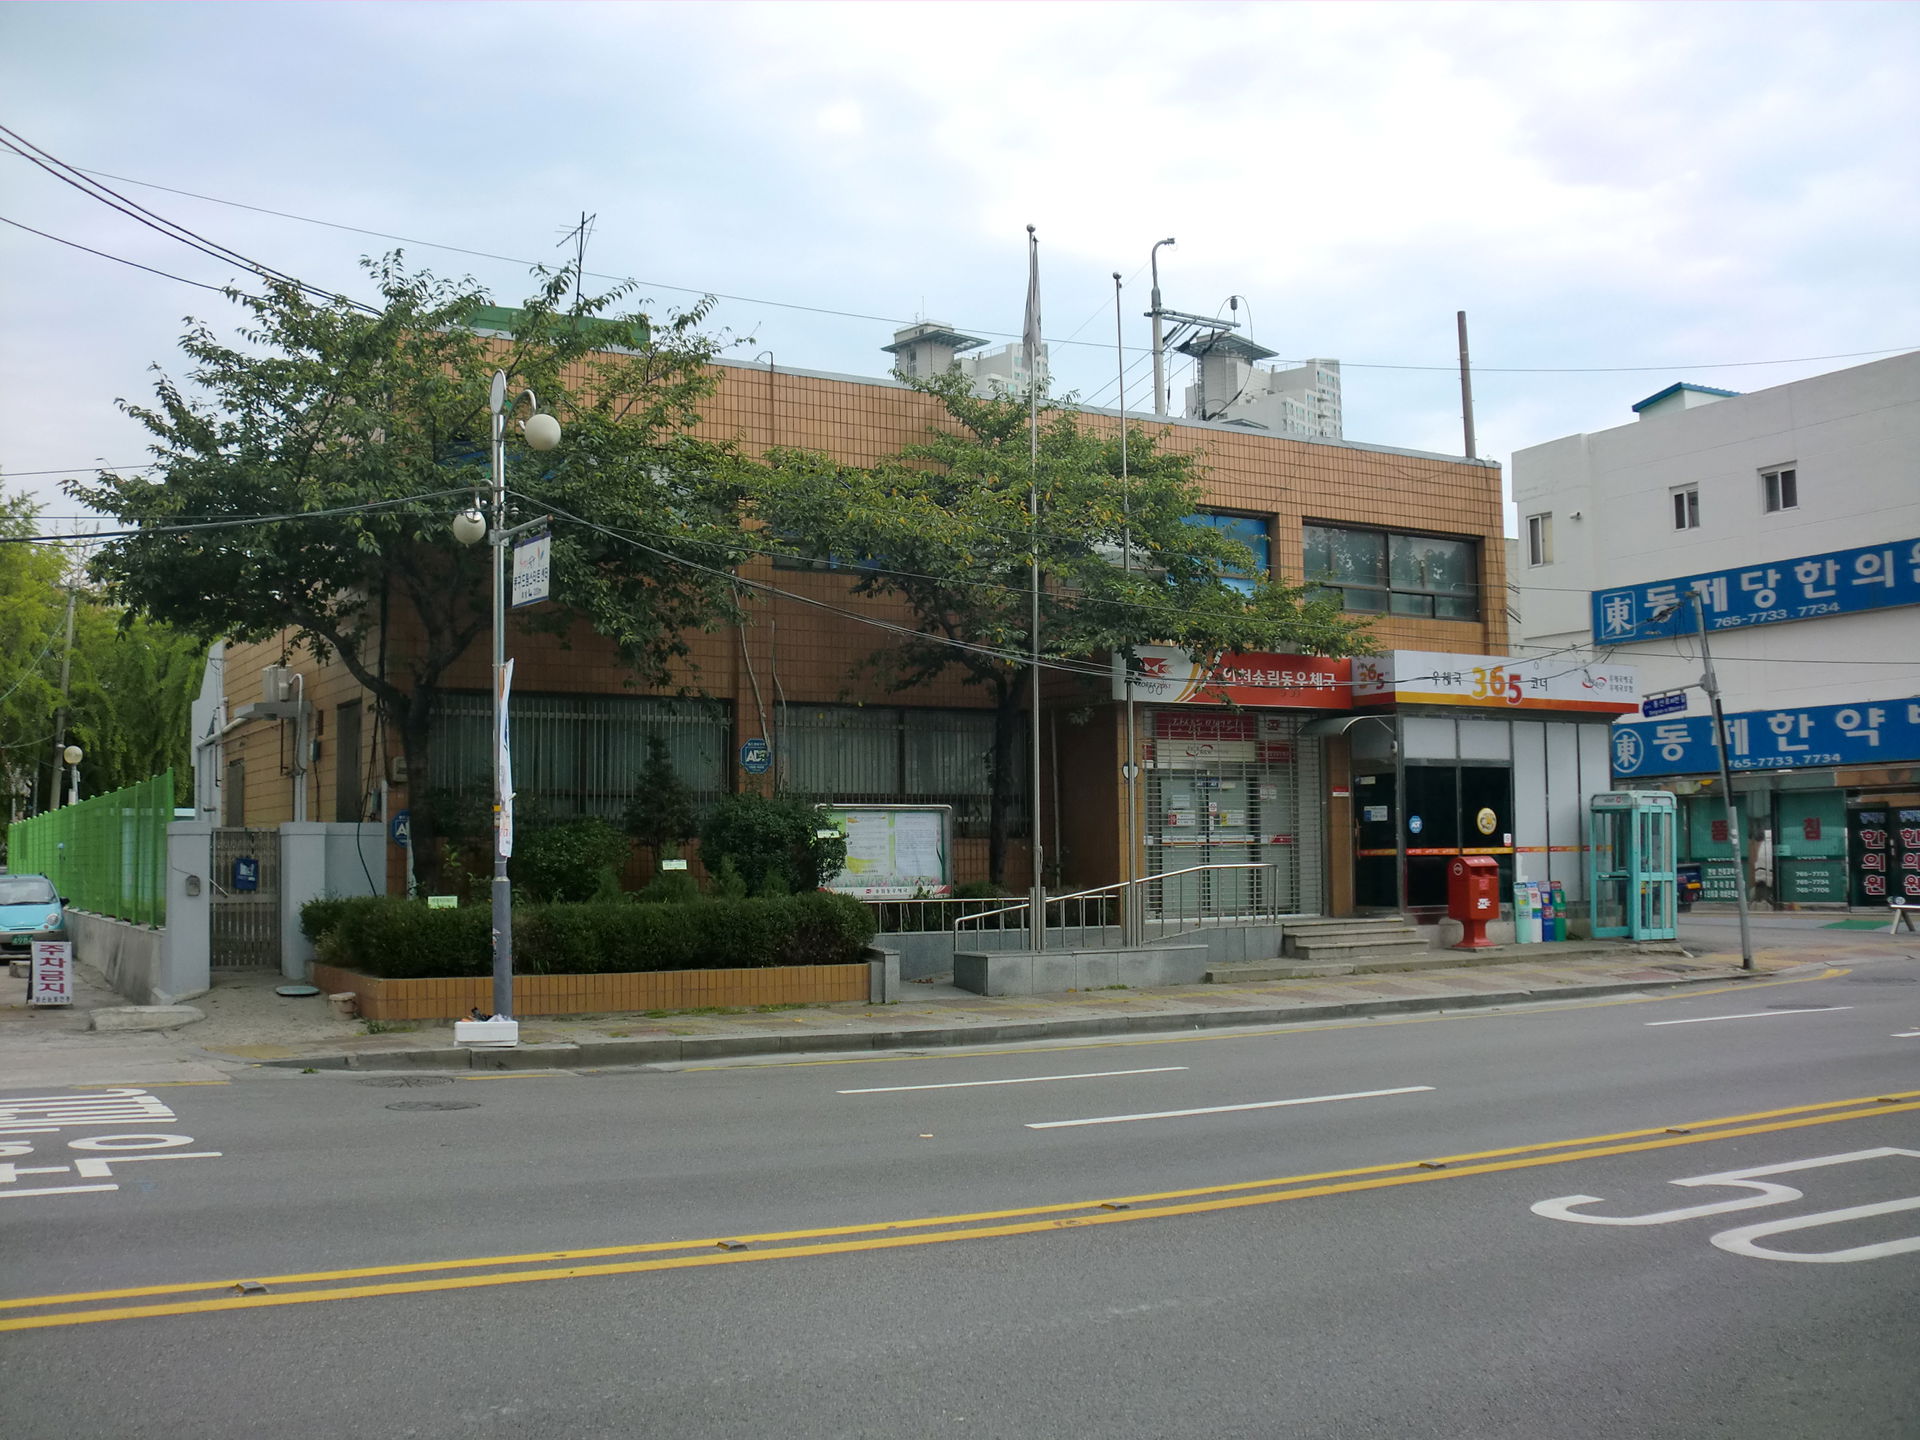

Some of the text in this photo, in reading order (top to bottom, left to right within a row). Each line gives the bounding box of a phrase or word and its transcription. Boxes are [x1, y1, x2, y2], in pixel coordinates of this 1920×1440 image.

[1604, 597, 1634, 634] 東
[1433, 665, 1548, 703] 우체국 365 코너
[1615, 735, 1637, 768] 東
[1653, 703, 1920, 762] 동제한약
[1860, 829, 1887, 895] 한의원
[40, 944, 66, 994] 주차금지
